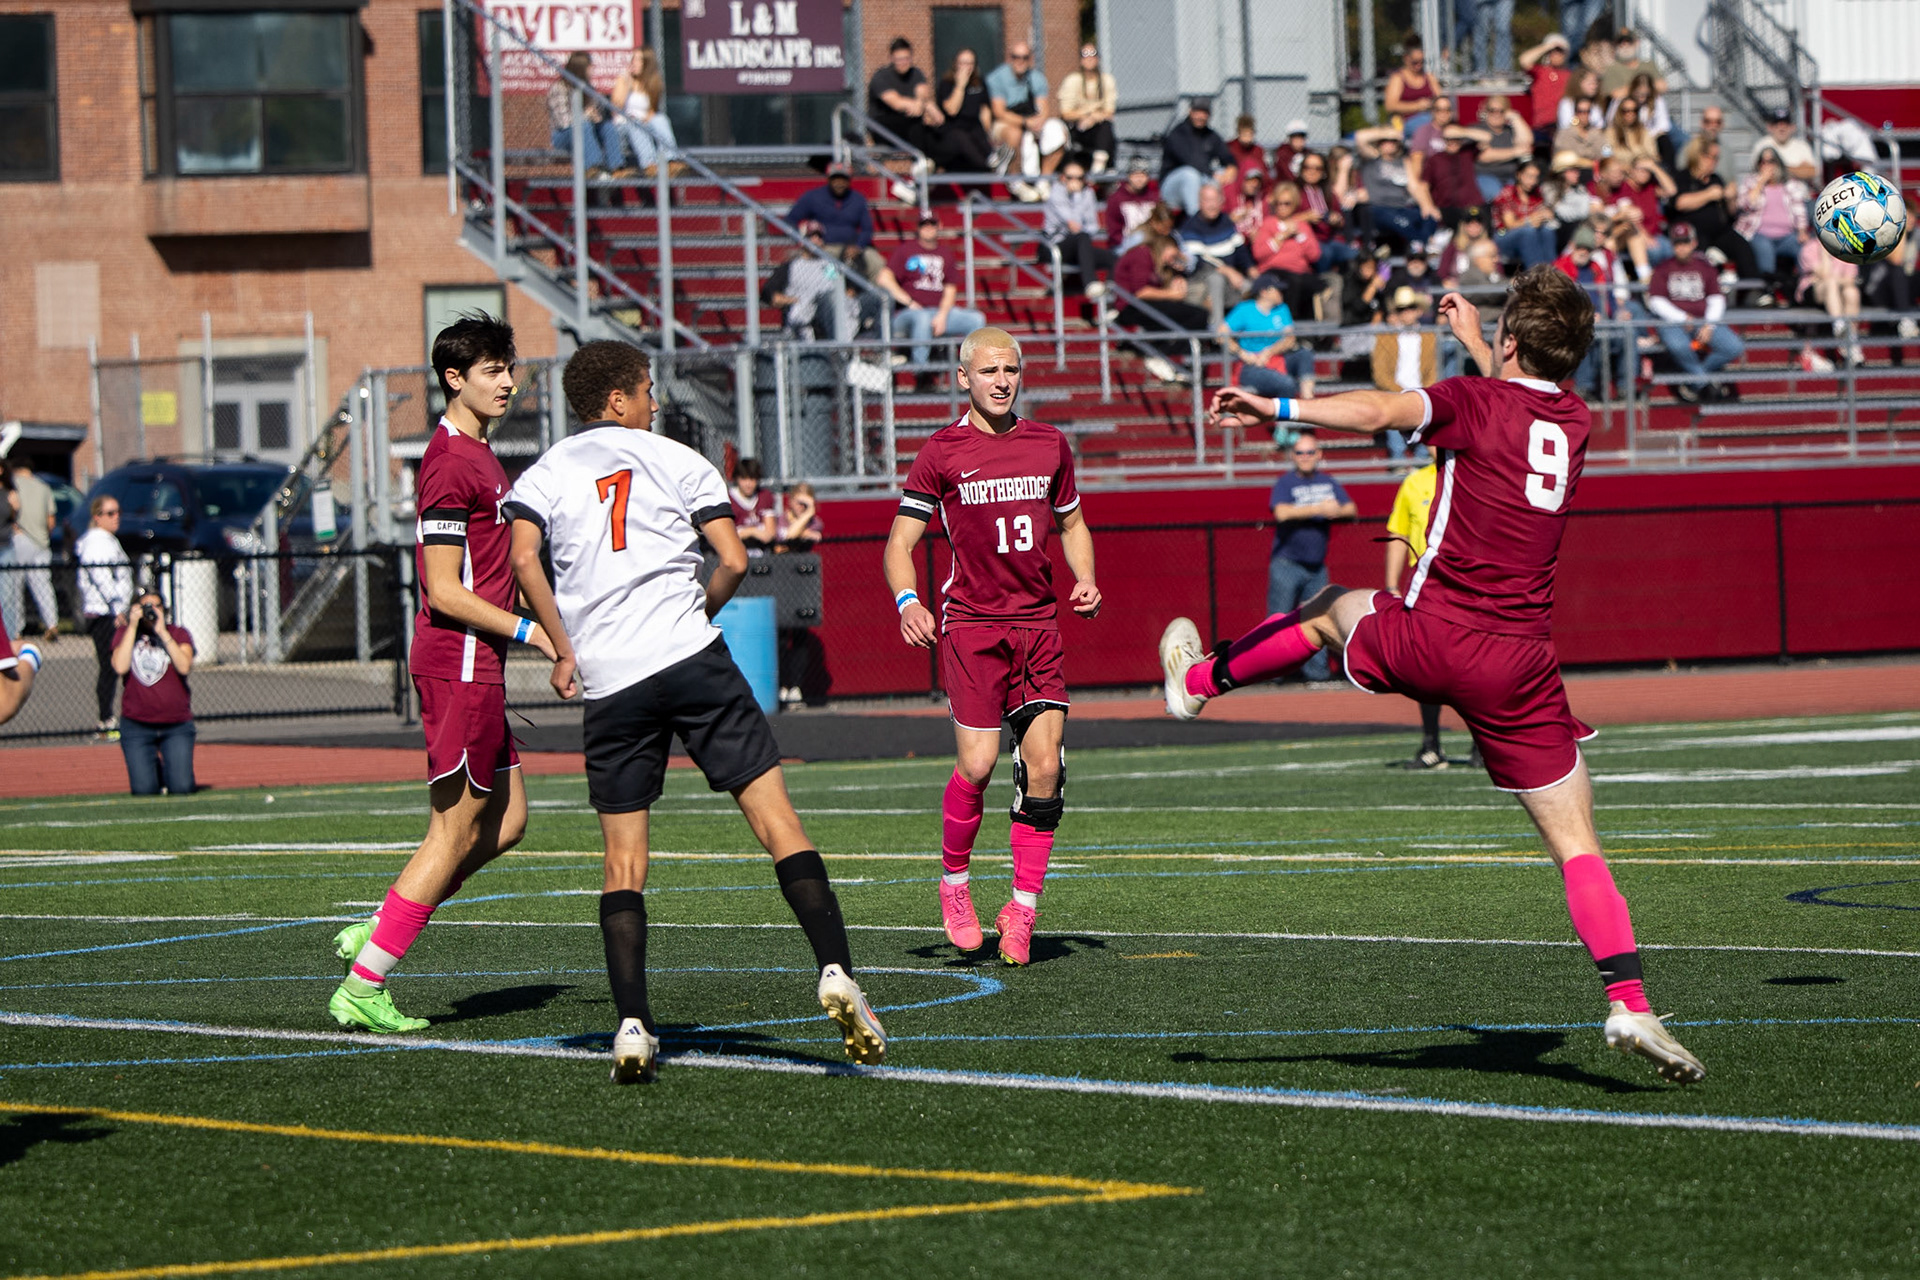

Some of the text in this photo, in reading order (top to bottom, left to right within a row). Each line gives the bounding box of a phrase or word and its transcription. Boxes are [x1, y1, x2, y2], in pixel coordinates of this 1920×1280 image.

[730, 1, 751, 36] L
[752, 2, 774, 36] &
[774, 1, 799, 36] M
[687, 38, 813, 69] LANDSCAPE
[1816, 186, 1855, 221] SELECT
[1524, 418, 1570, 512] 9
[957, 475, 1051, 505] NORTHBRIDGE
[595, 468, 632, 552] 7
[995, 514, 1034, 554] 13
